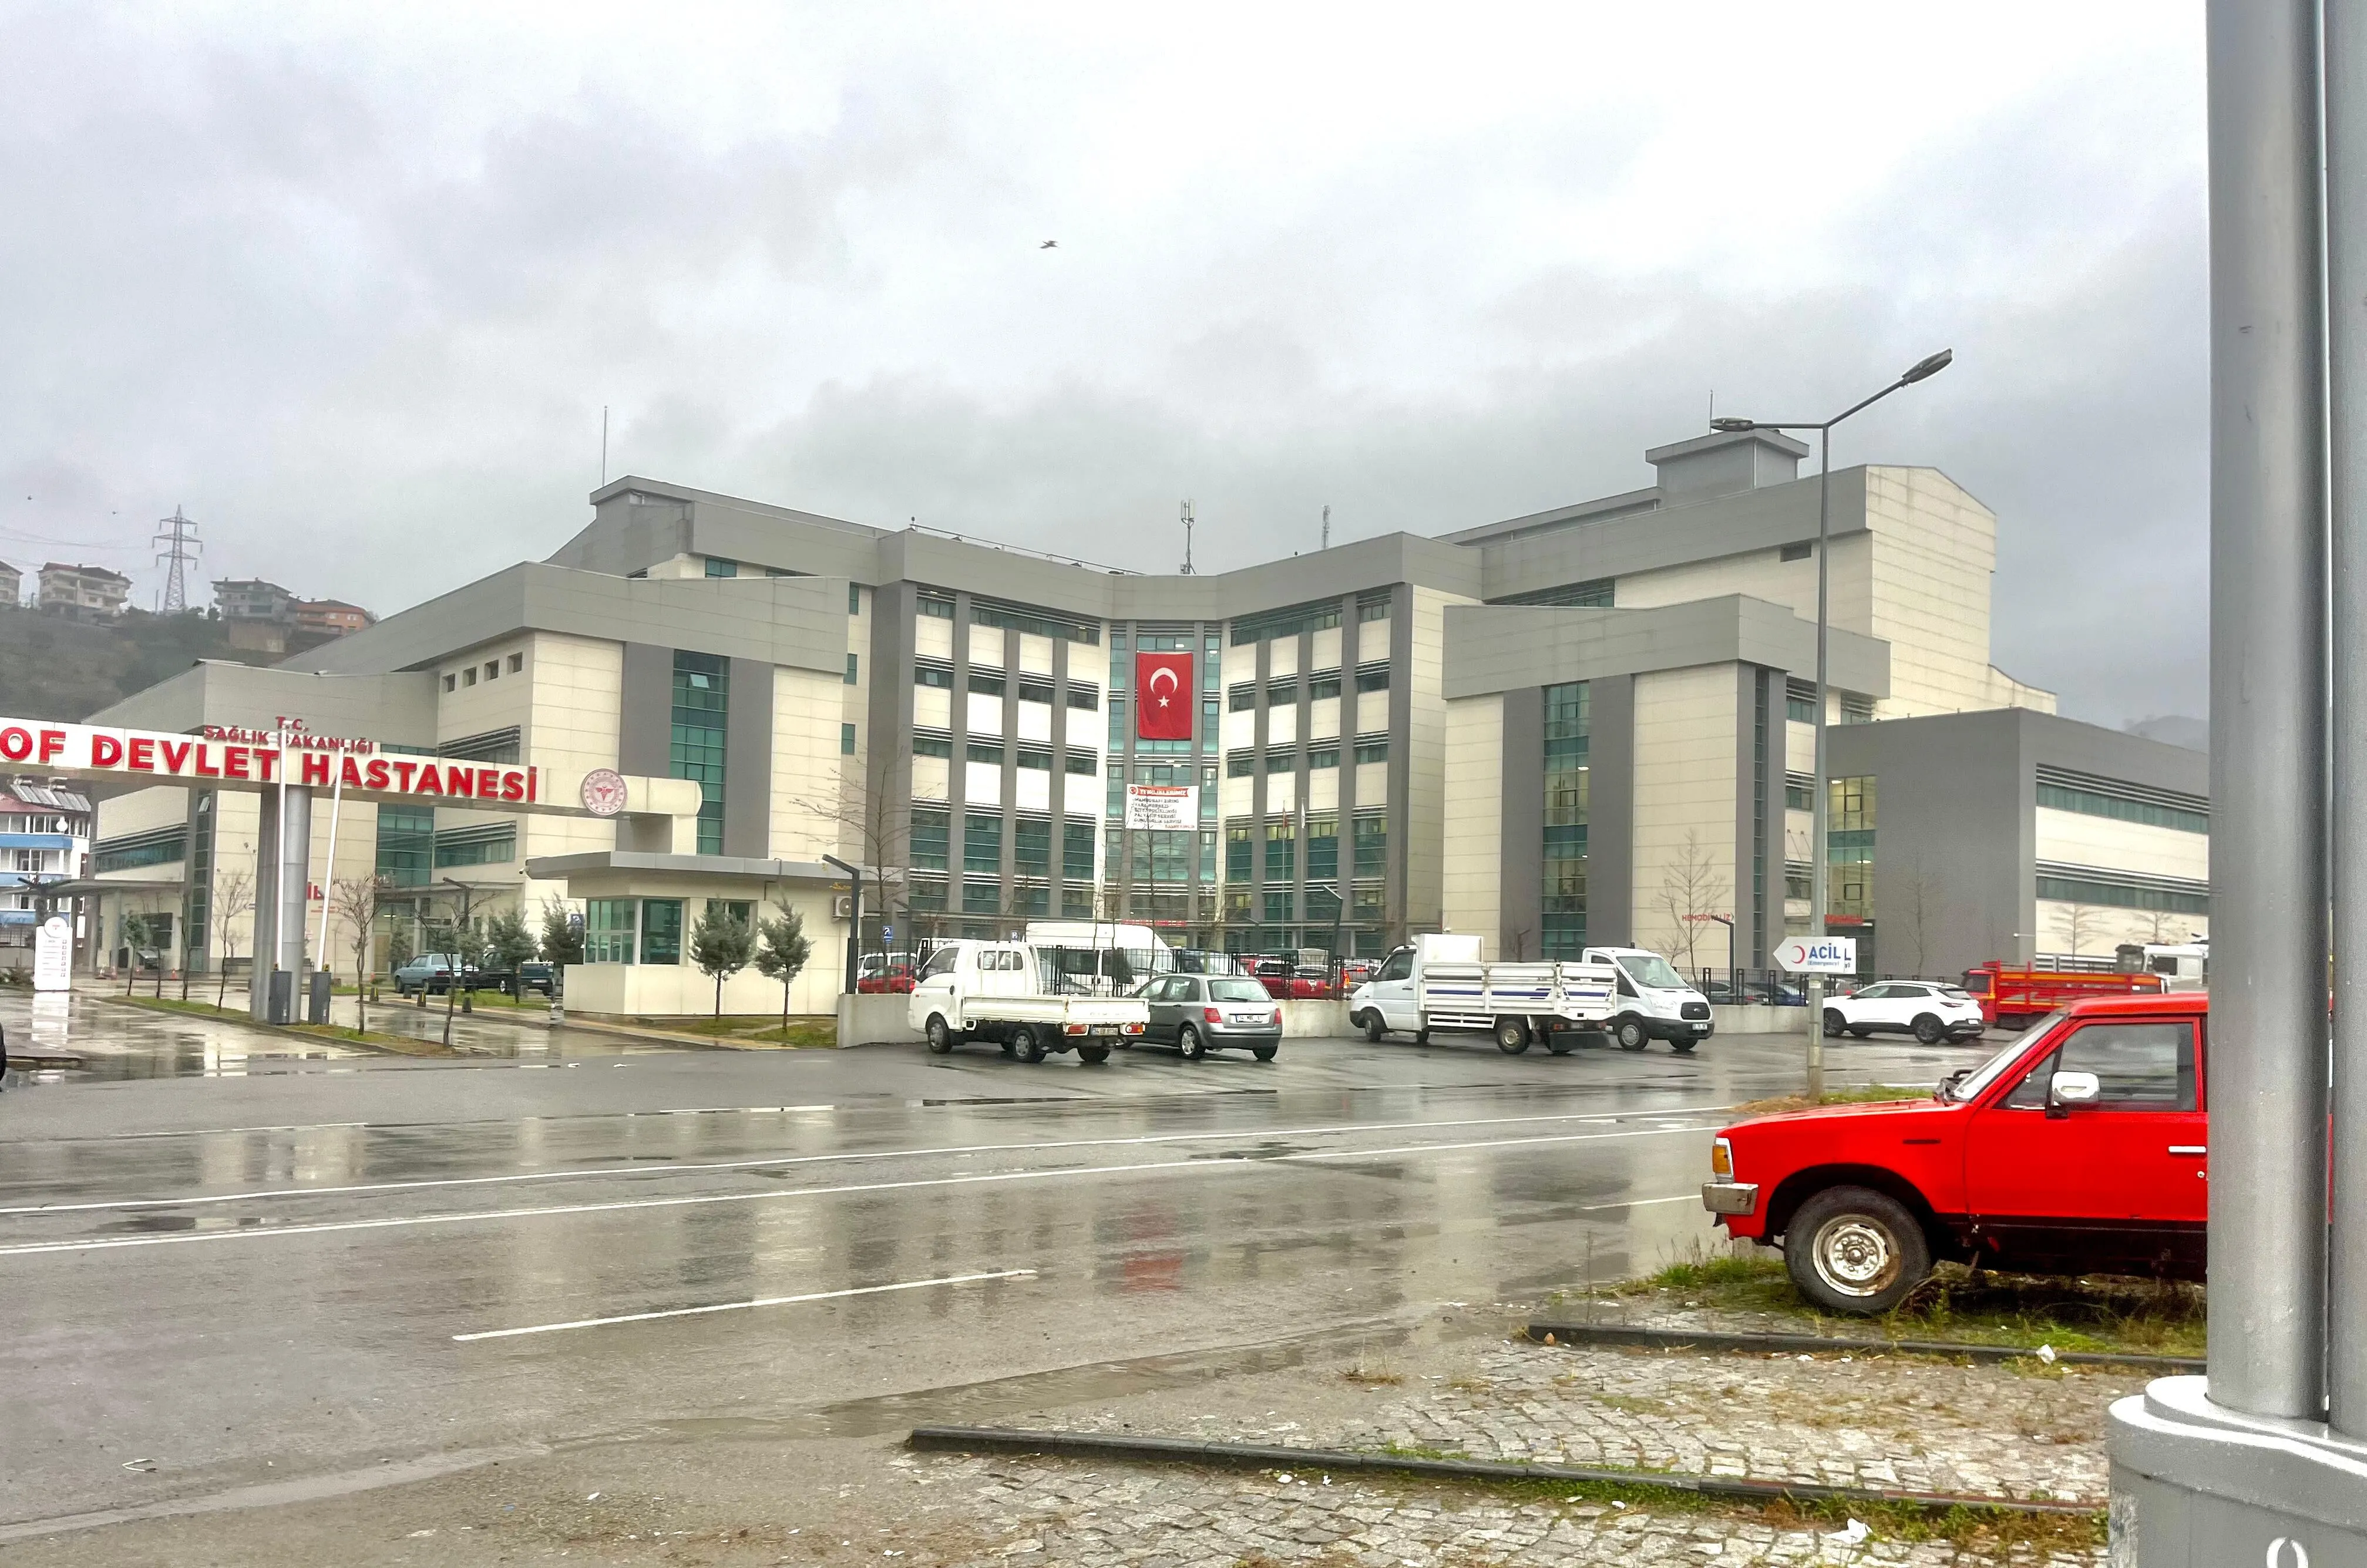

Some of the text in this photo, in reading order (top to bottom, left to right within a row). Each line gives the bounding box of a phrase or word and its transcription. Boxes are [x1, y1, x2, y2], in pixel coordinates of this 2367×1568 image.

[203, 724, 270, 745] SAĞLIK
[0, 726, 66, 763] OF
[91, 734, 280, 782] DEVLET
[301, 752, 537, 802] HASTANESİ
[1809, 943, 1841, 959] ACİL
